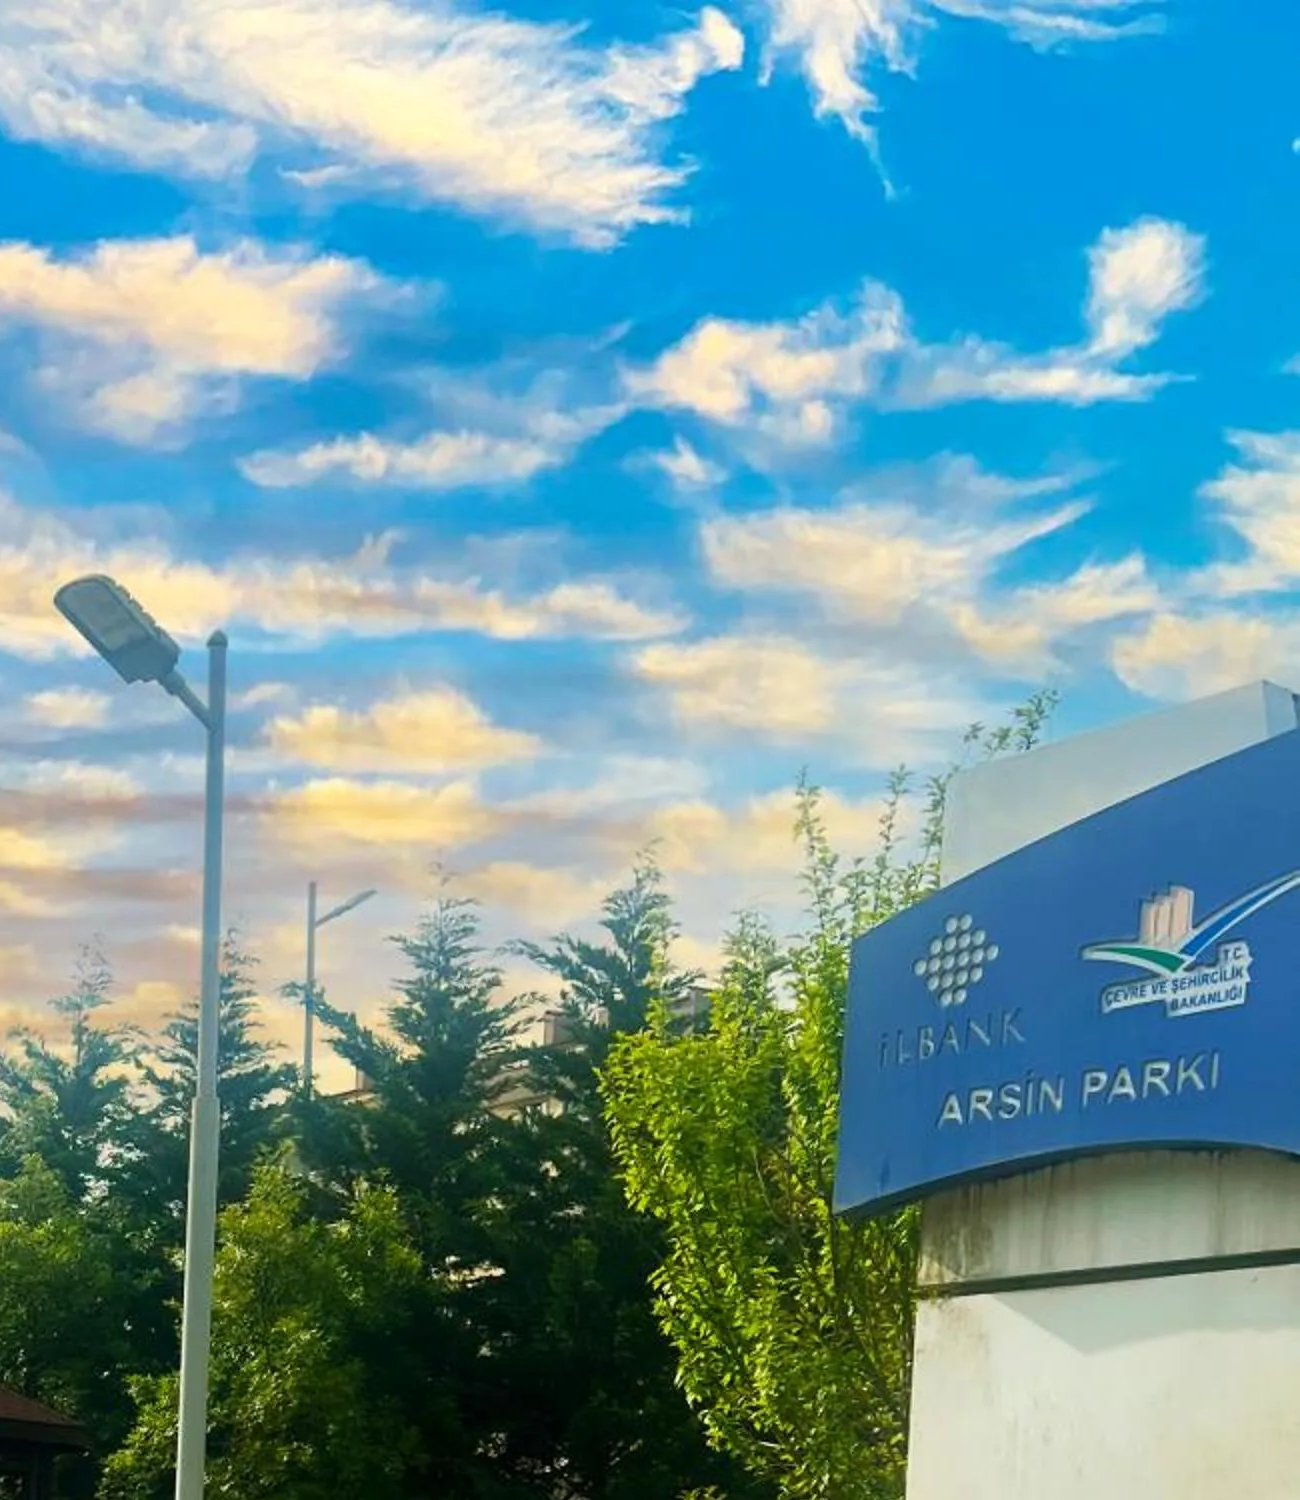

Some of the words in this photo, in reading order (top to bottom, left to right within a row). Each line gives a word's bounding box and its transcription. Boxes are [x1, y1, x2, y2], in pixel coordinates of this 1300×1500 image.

[1104, 984, 1147, 1007] ÇEVRE
[1151, 979, 1168, 995] VE
[1170, 984, 1243, 1011] BAKANLIĞI
[935, 1069, 1065, 1130] ARSİN
[1081, 1049, 1220, 1108] PARKI
